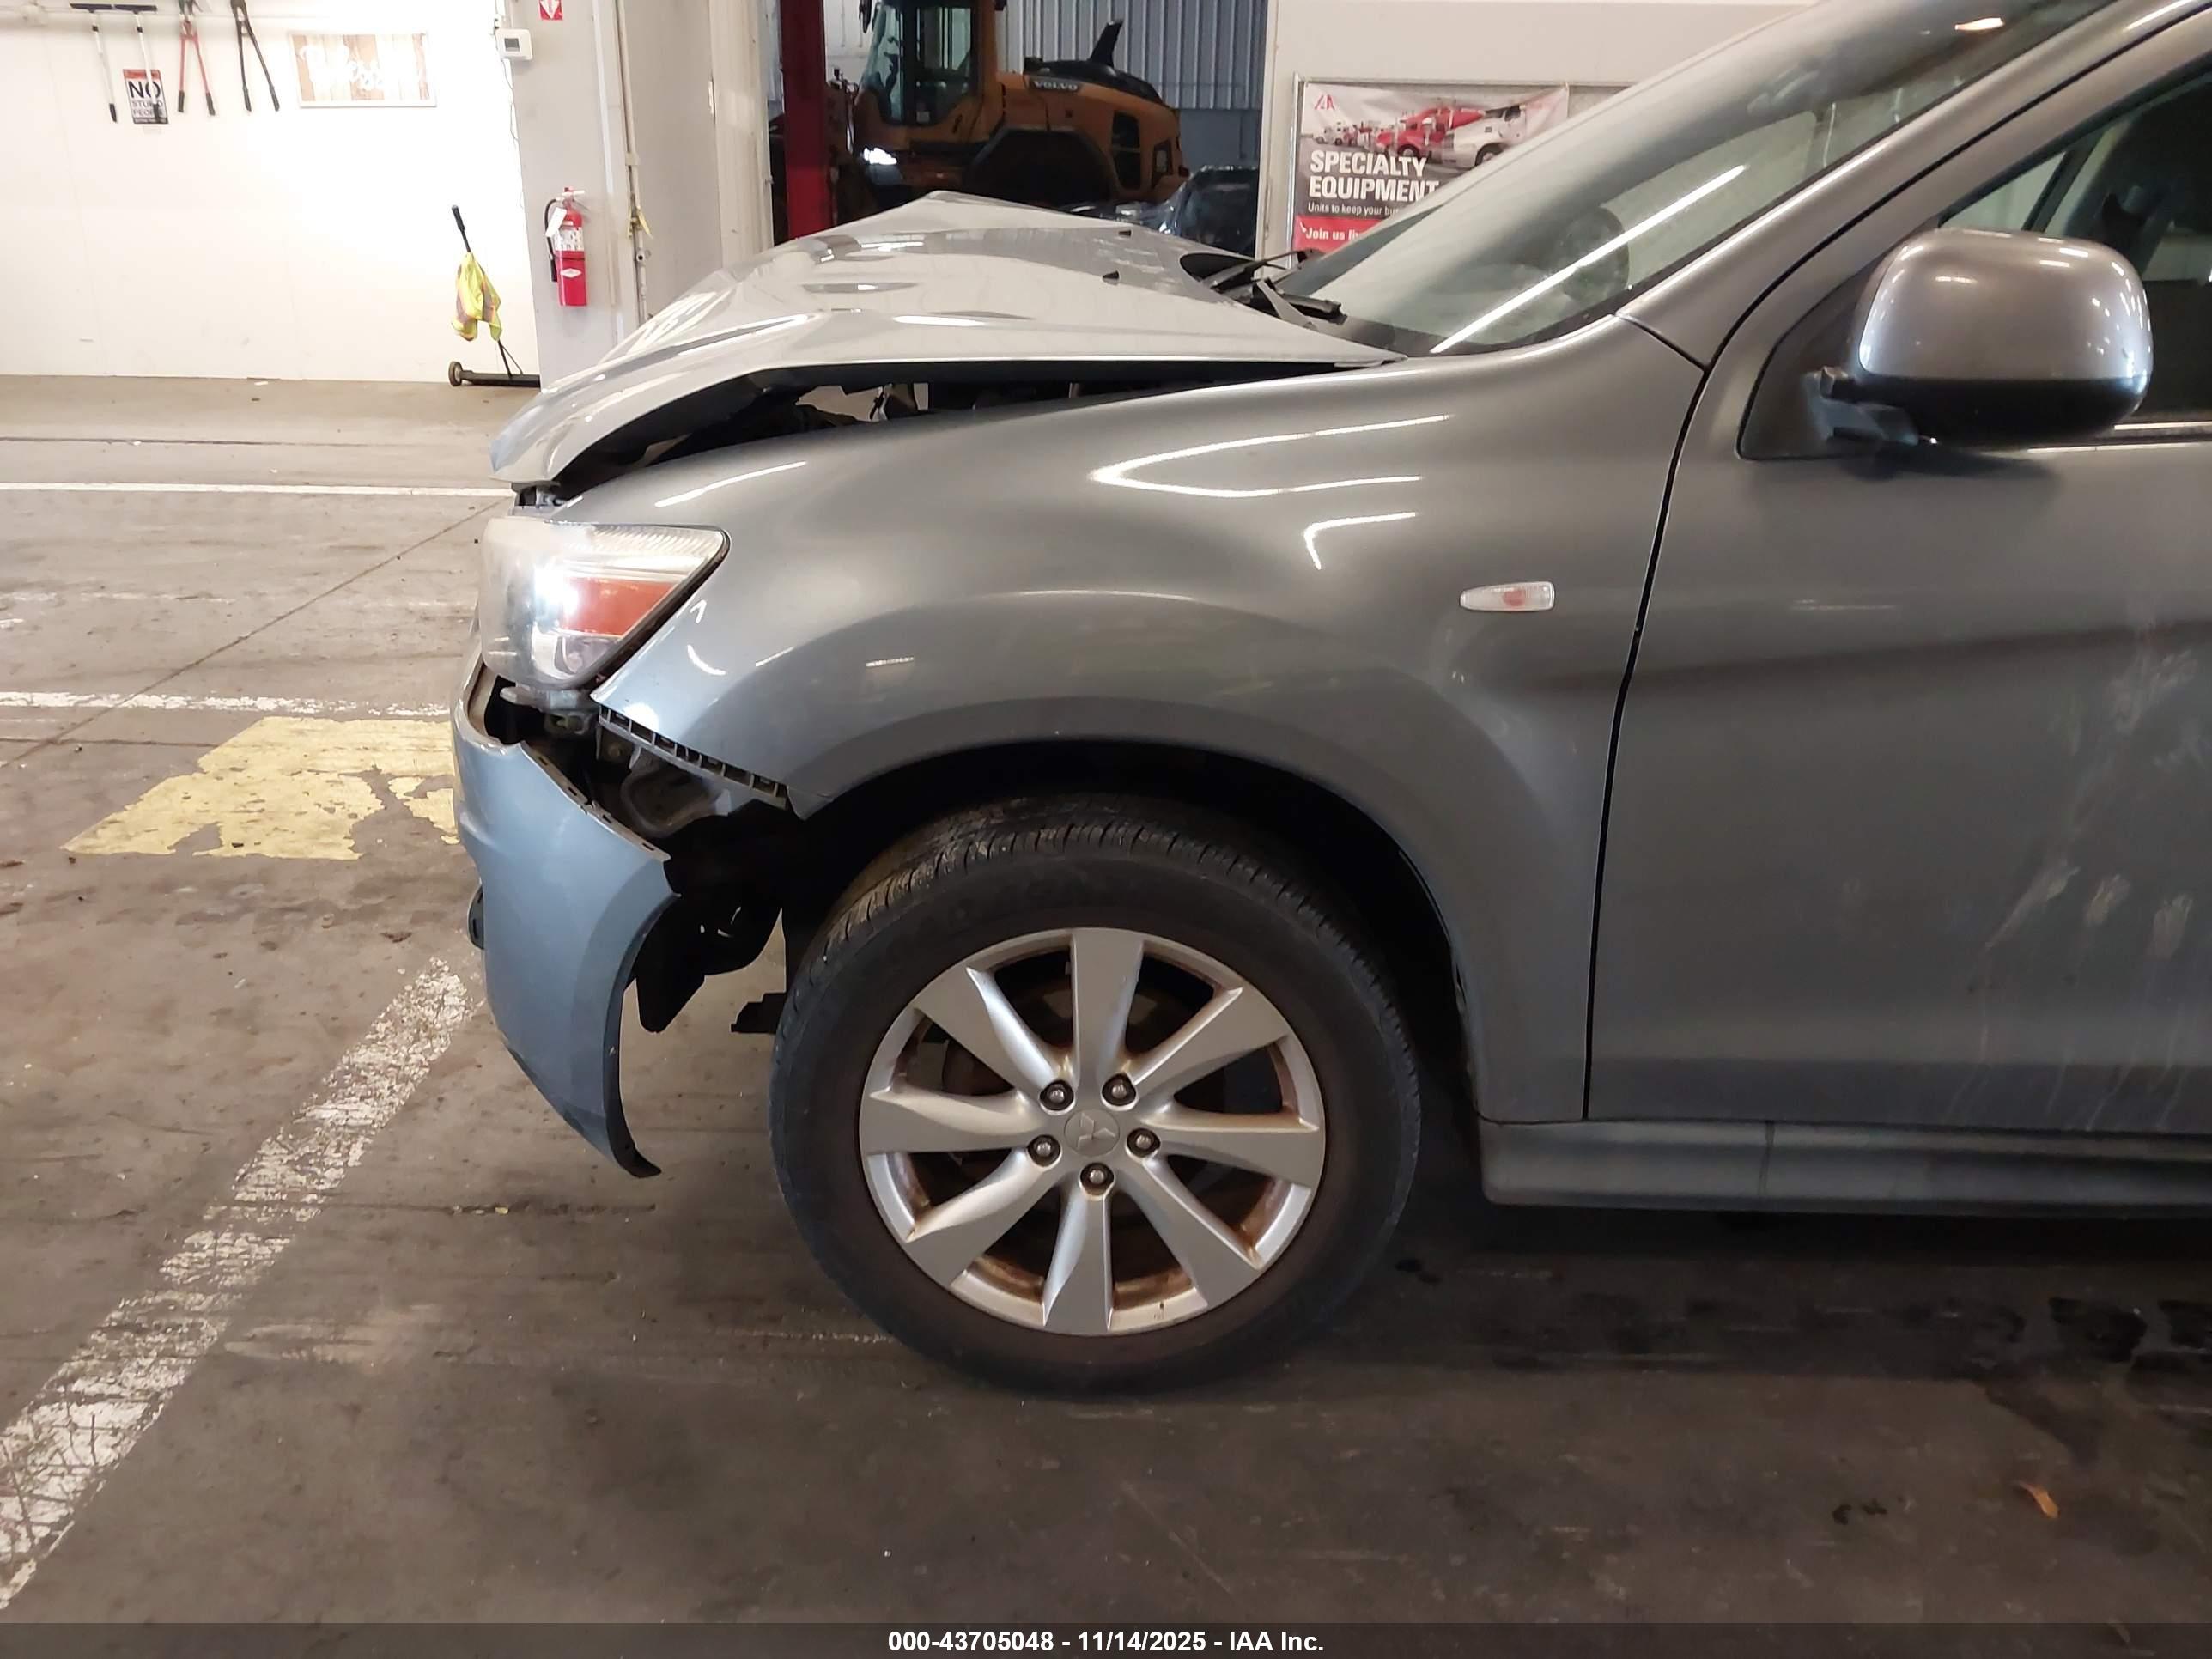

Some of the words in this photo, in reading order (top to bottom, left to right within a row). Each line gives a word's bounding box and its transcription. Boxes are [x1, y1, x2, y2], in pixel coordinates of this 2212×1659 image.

[128, 81, 161, 99] NO
[1033, 81, 1078, 91] VOLVO
[132, 100, 163, 108] STUPD
[1310, 149, 1427, 177] SPECIALTY
[1309, 175, 1440, 202] EQUIPMENT
[1308, 201, 1330, 213] Units
[1331, 204, 1340, 214] to
[1341, 203, 1362, 216] keep
[1364, 205, 1382, 217] your
[1305, 228, 1329, 240] Join
[1333, 231, 1346, 241] us
